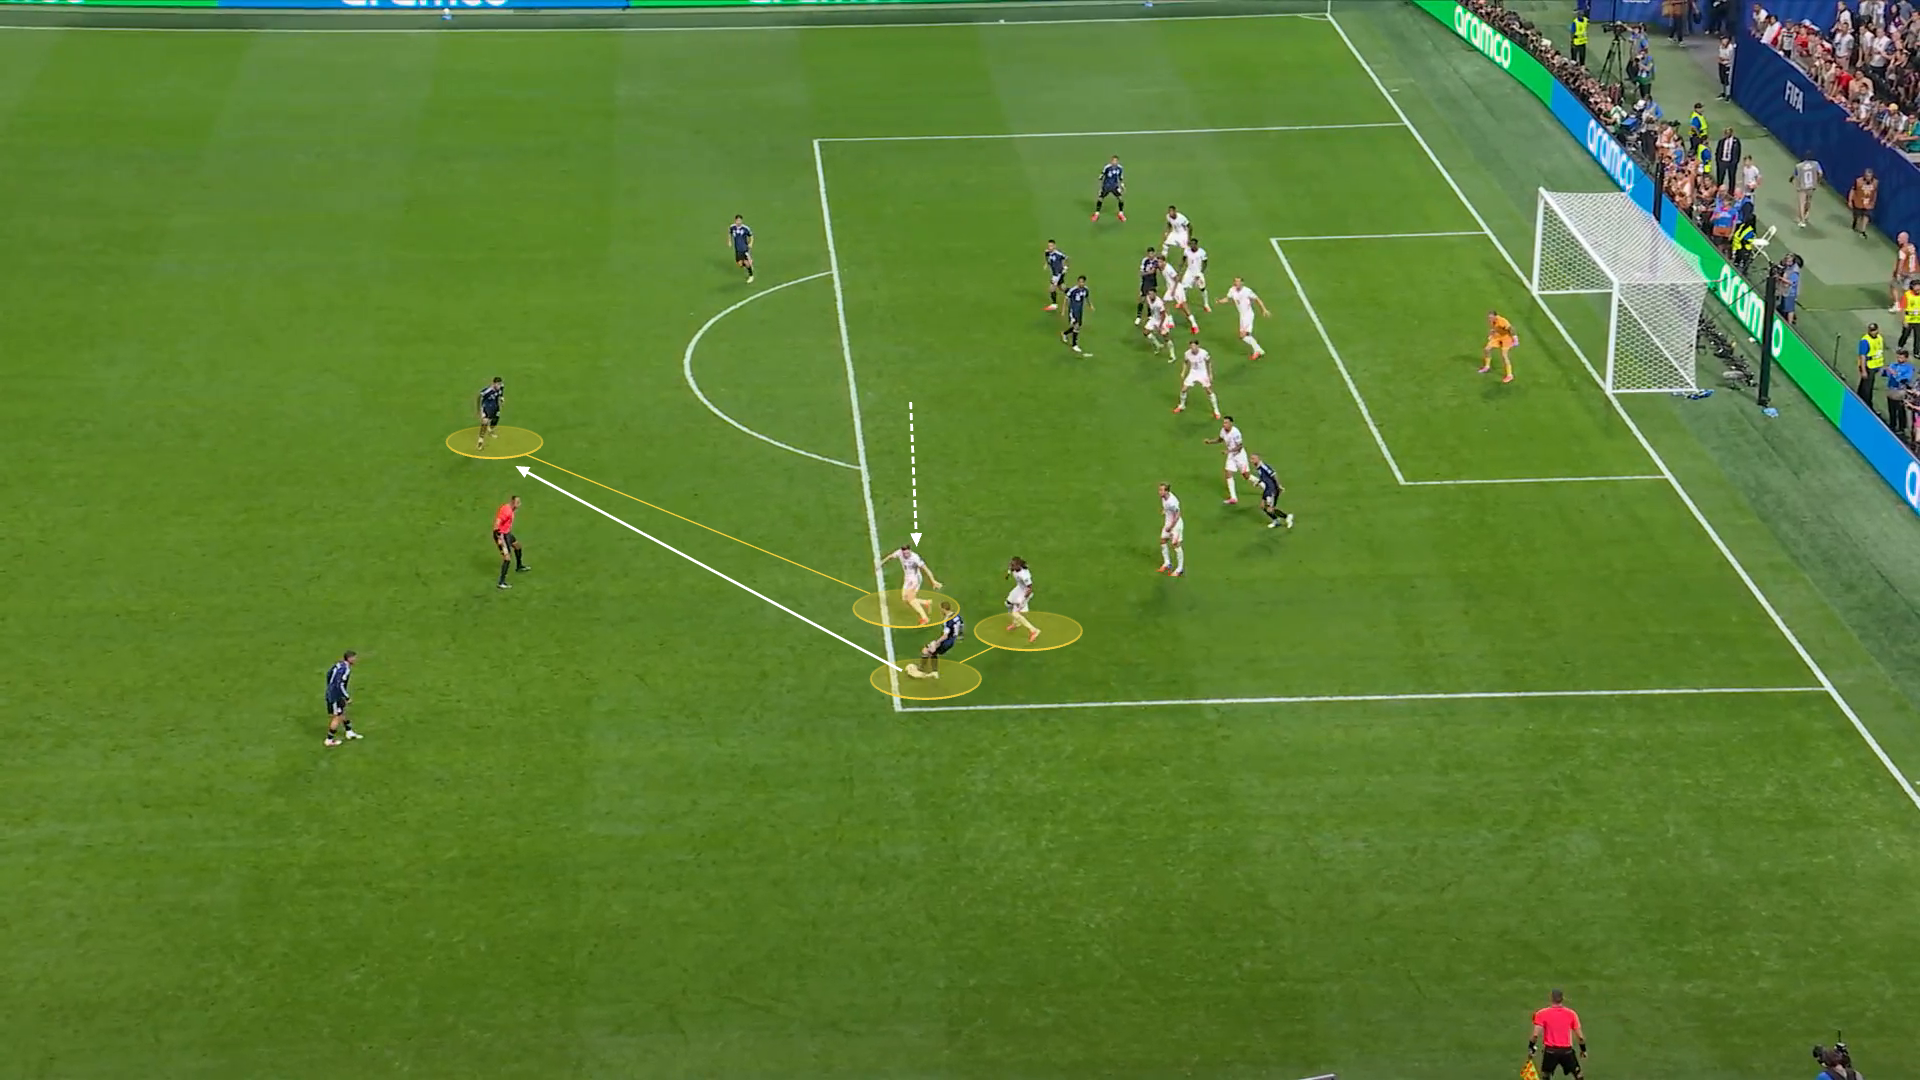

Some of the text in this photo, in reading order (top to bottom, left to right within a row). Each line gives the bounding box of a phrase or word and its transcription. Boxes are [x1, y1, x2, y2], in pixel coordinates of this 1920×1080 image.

[1455, 5, 1511, 69] aramco
[1785, 80, 1804, 114] FIFA
[1588, 118, 1634, 191] aramco
[1720, 263, 1783, 358] aramo
